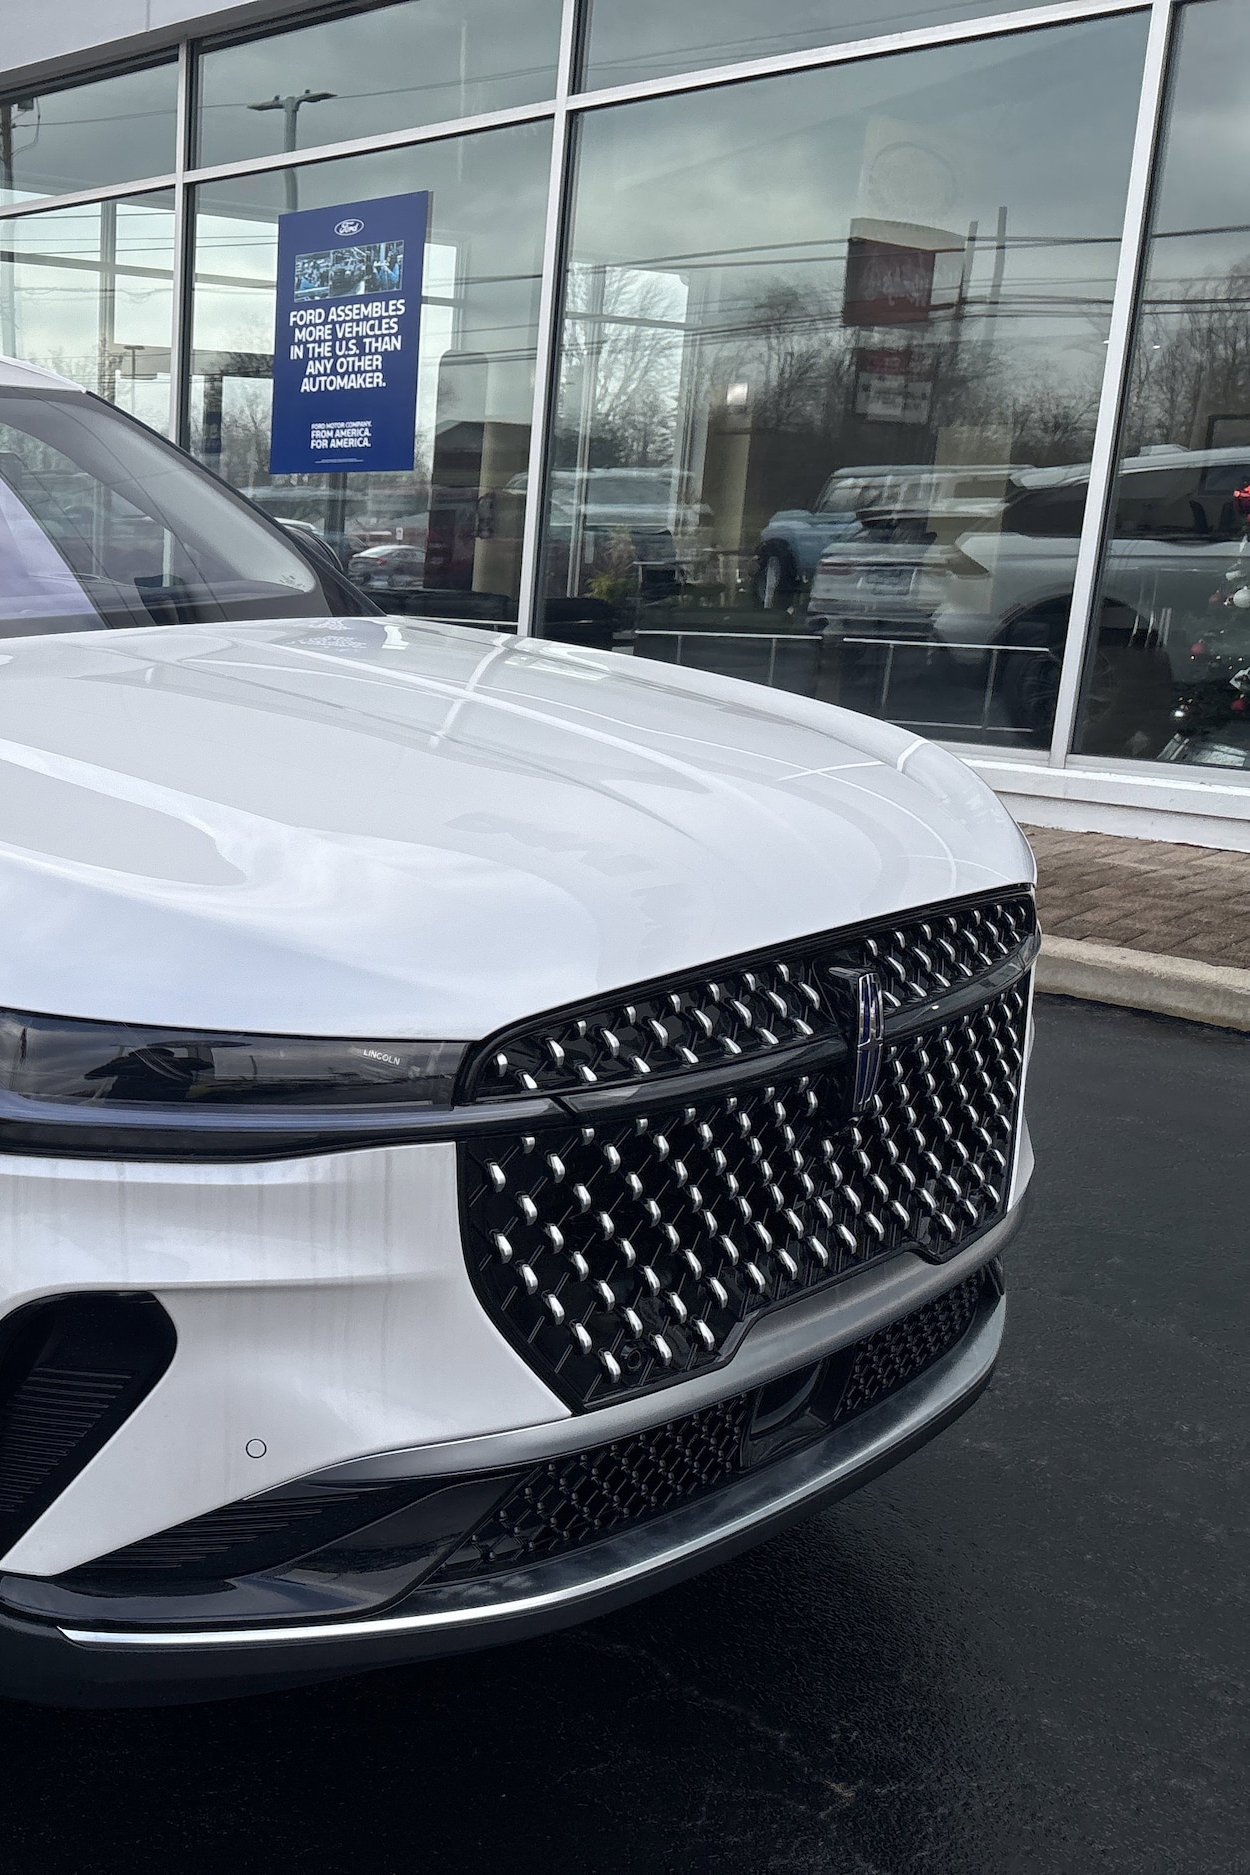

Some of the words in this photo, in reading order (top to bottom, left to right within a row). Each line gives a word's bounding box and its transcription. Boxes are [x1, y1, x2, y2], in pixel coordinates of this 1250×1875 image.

[289, 308, 325, 326] FORD
[328, 299, 405, 322] ASSEMBLES
[294, 325, 332, 342] MORE
[335, 318, 398, 338] VEHICLES
[290, 344, 304, 360] IN
[306, 342, 332, 358] THE
[335, 339, 359, 355] U.S.
[363, 335, 402, 353] THAN
[305, 359, 334, 375] ANY
[336, 354, 382, 373] OTHER
[300, 372, 386, 393] AUTOMAKER.
[310, 439, 329, 449] FOR
[329, 437, 371, 448] AMERICA.
[311, 430, 334, 439] FROM
[334, 428, 372, 438] AMERICA.
[363, 1049, 401, 1065] LINCOLN
